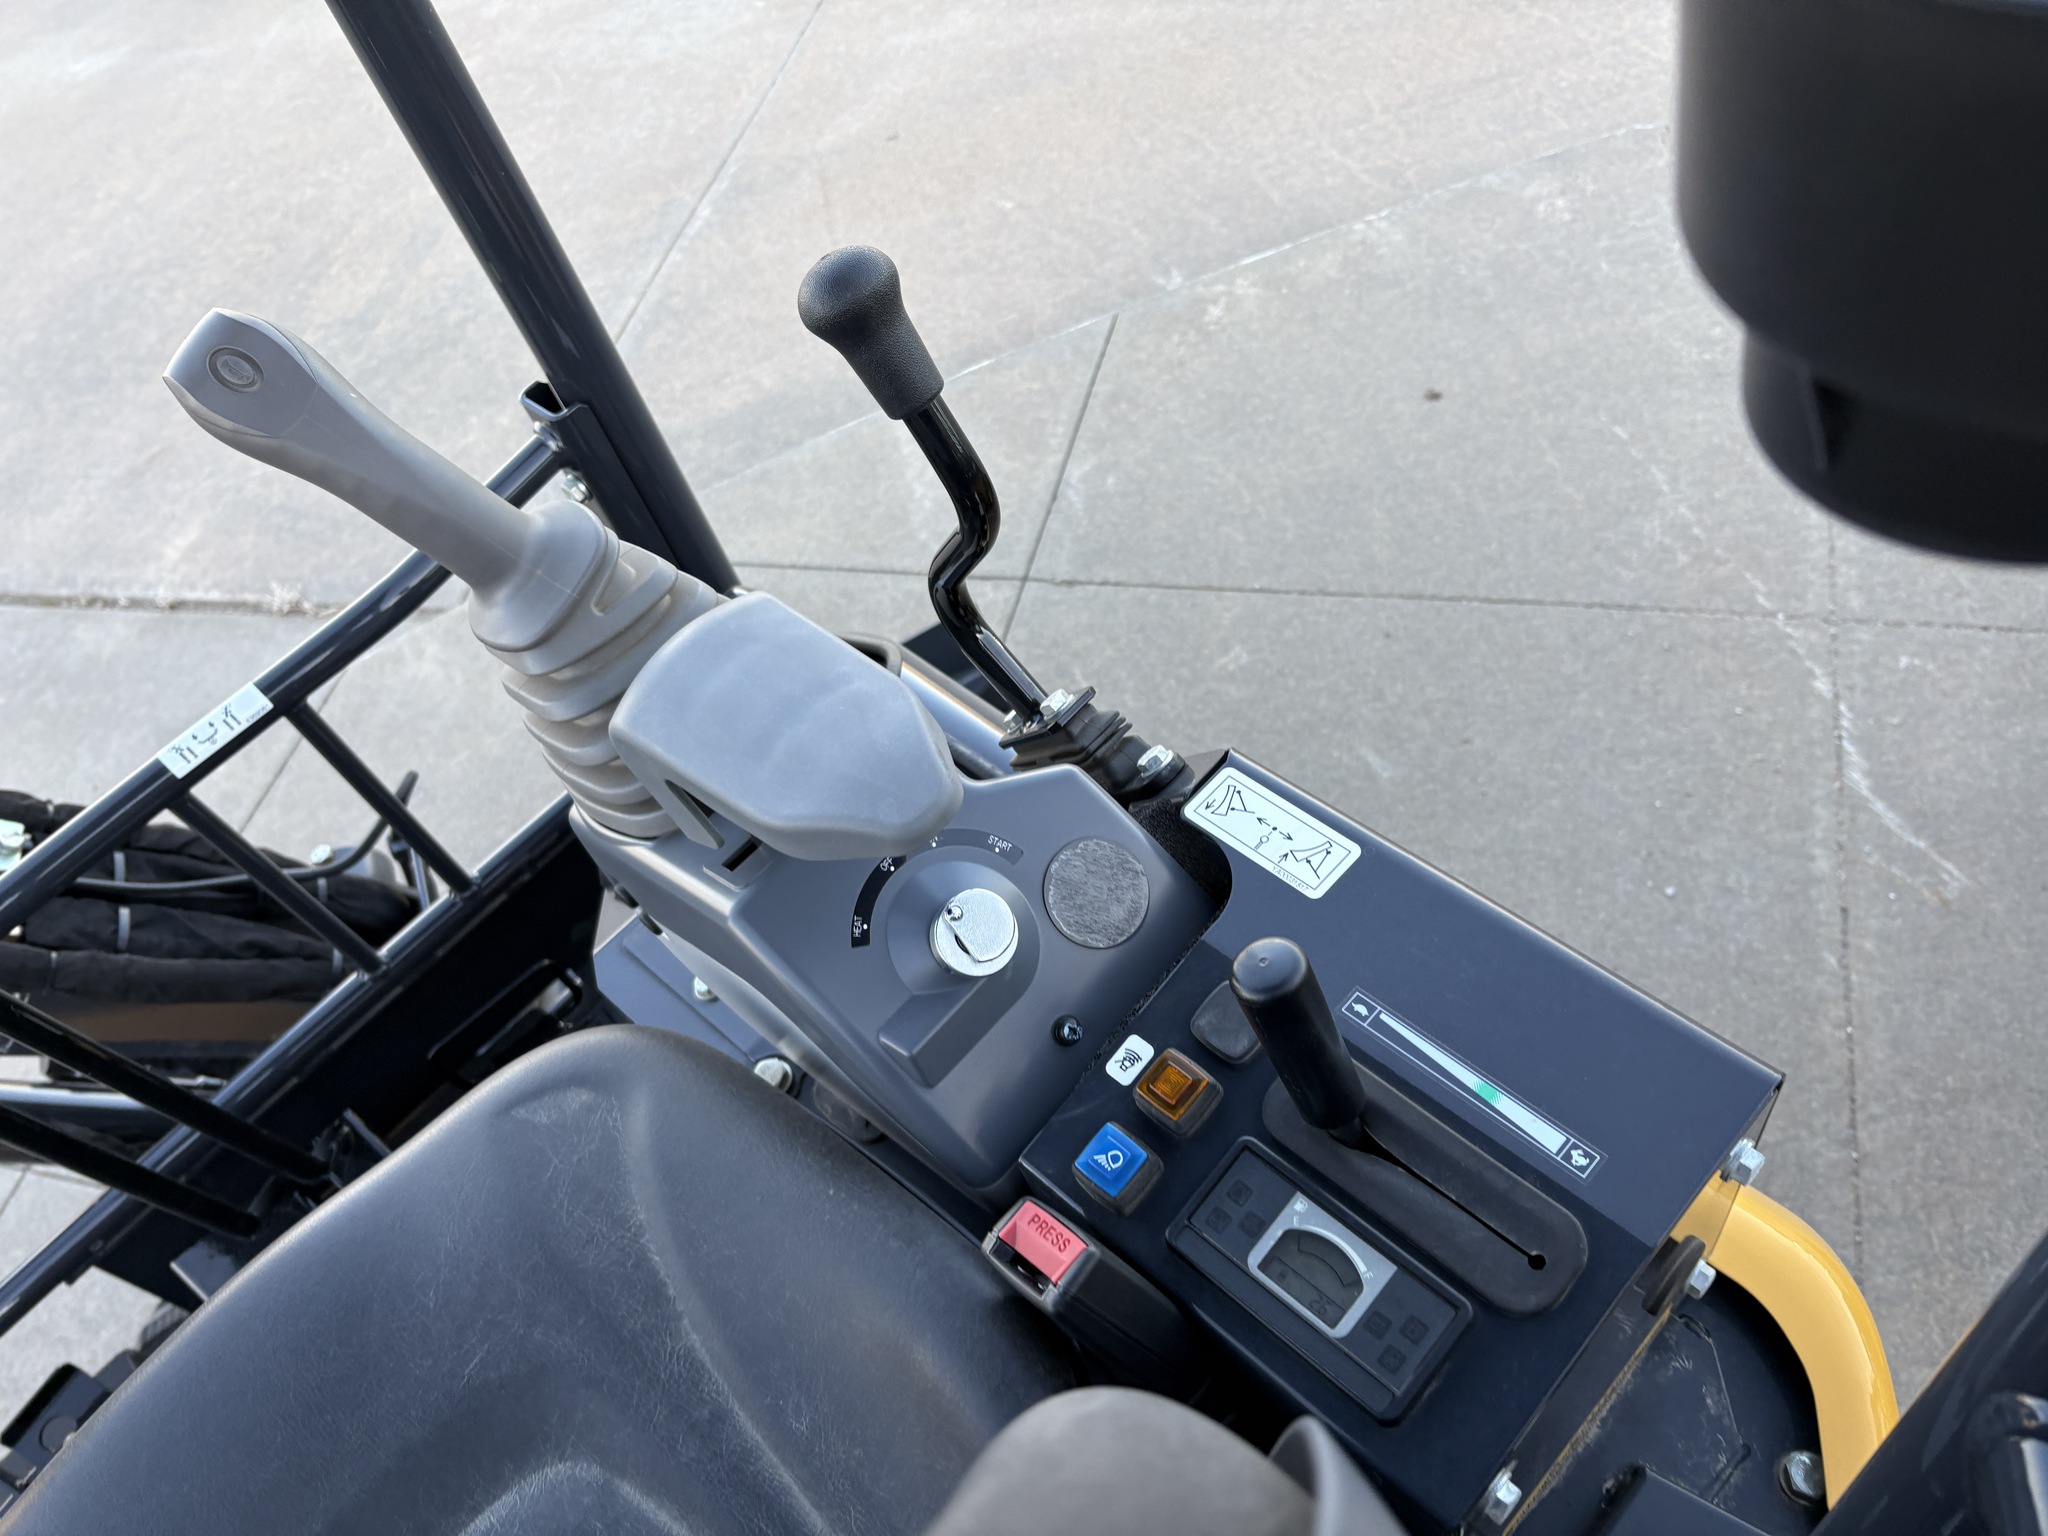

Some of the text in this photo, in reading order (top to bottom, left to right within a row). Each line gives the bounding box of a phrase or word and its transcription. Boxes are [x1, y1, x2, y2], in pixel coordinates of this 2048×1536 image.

[988, 835, 1012, 852] START
[880, 857, 893, 871] OFF
[853, 915, 863, 938] HEAT
[1027, 1213, 1071, 1253] PRESS
[1363, 1271, 1373, 1280] F
